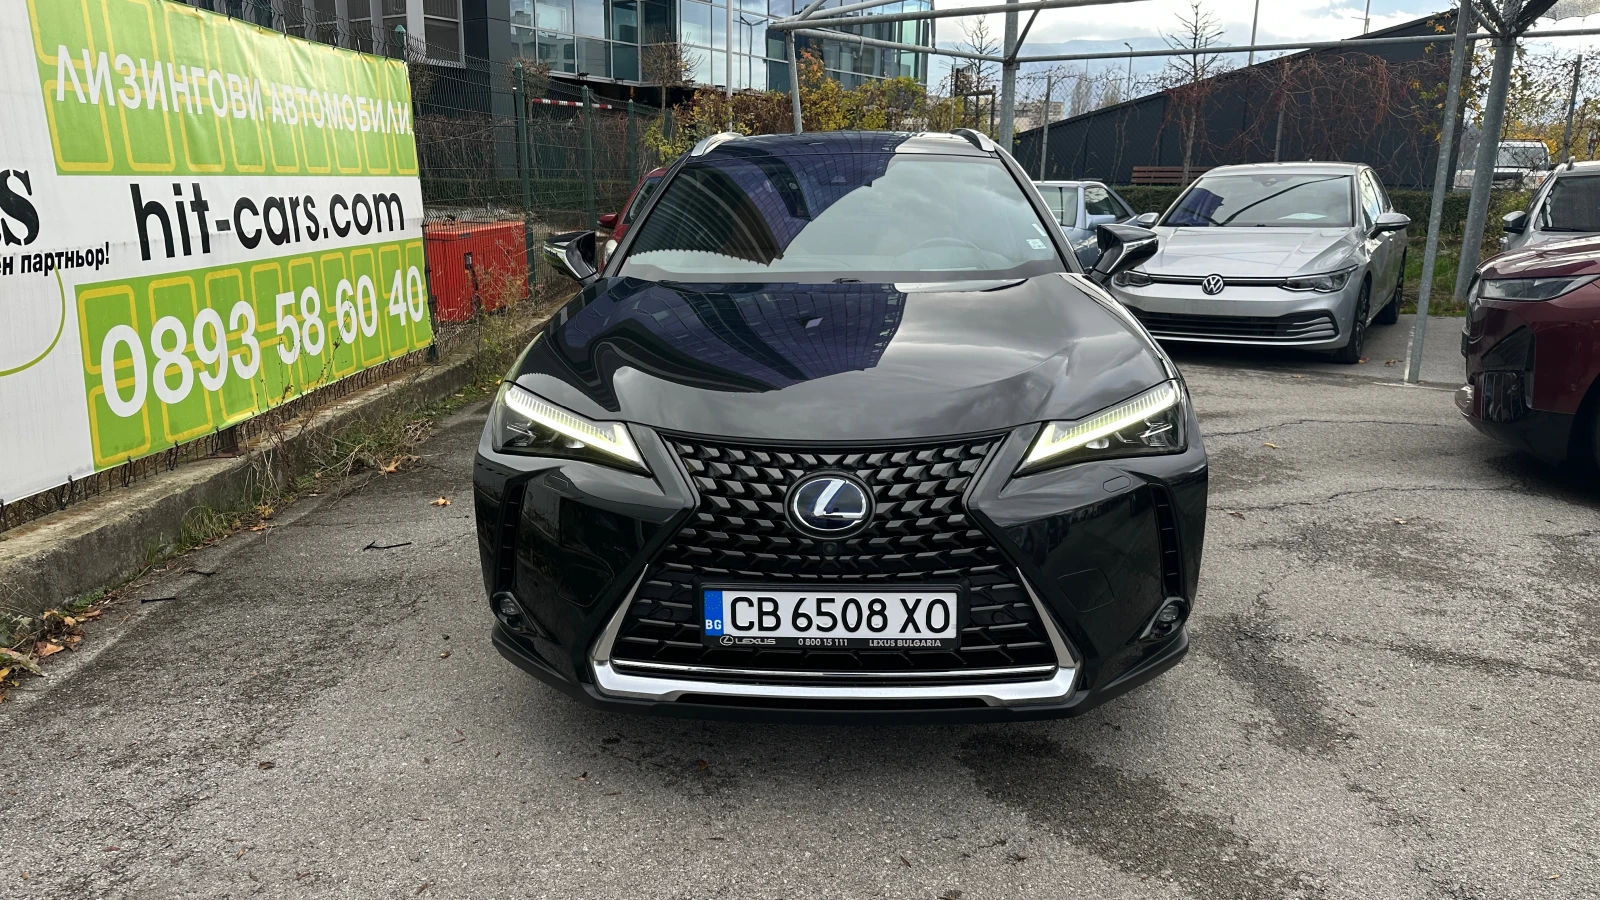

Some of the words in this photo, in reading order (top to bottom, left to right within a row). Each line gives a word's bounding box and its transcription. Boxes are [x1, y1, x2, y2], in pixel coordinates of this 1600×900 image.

[56, 45, 265, 122] ЛИЗИНГОВИ
[270, 82, 411, 135] АВТОМОБИЛИ
[130, 182, 405, 261] hit-cars.com
[0, 256, 13, 275] н
[21, 241, 110, 276] партньор!
[101, 300, 261, 418] 0893
[275, 286, 325, 365] 58
[335, 274, 378, 345] 60
[389, 265, 424, 327] 40
[705, 619, 722, 630] BG
[730, 596, 782, 632] CB
[791, 597, 889, 633] 6508
[735, 637, 776, 645] LEXUS
